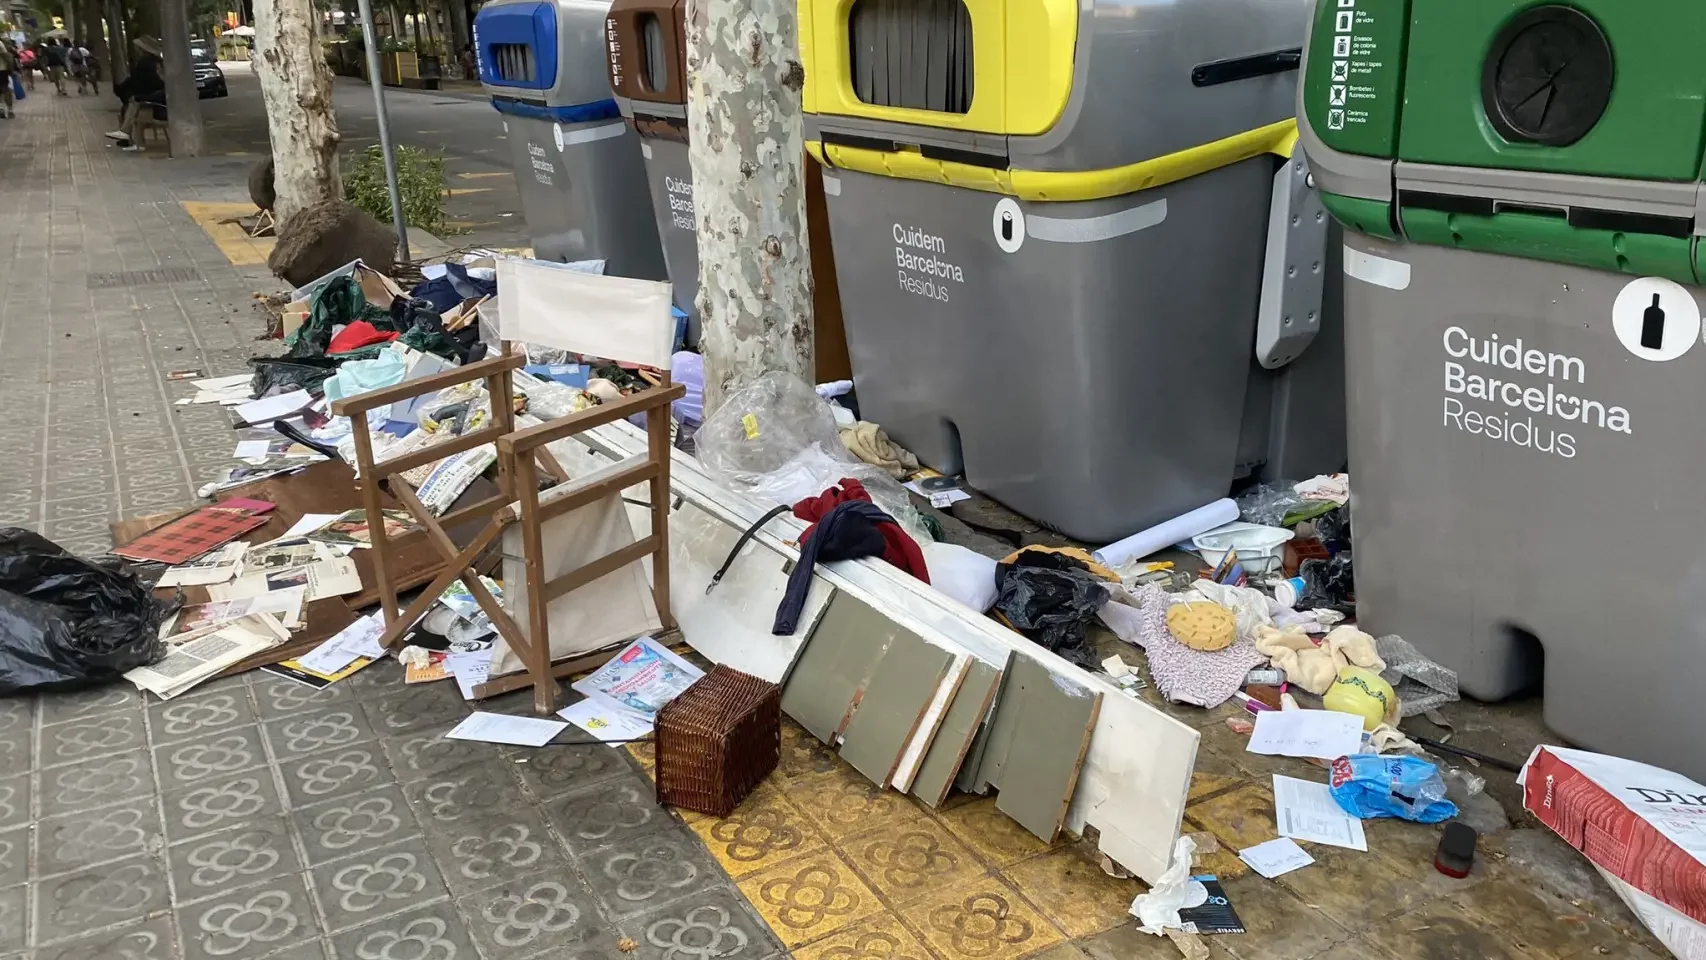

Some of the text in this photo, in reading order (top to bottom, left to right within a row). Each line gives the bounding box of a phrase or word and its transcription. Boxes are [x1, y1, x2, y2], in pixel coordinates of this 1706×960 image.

[669, 194, 694, 213] Barce
[892, 223, 946, 254] Cuidem
[895, 247, 964, 282] Barcelona
[898, 270, 949, 302] Residus
[1443, 326, 1585, 383] Cuidem
[1445, 361, 1632, 434] Barcelona
[1444, 396, 1576, 458] Residus
